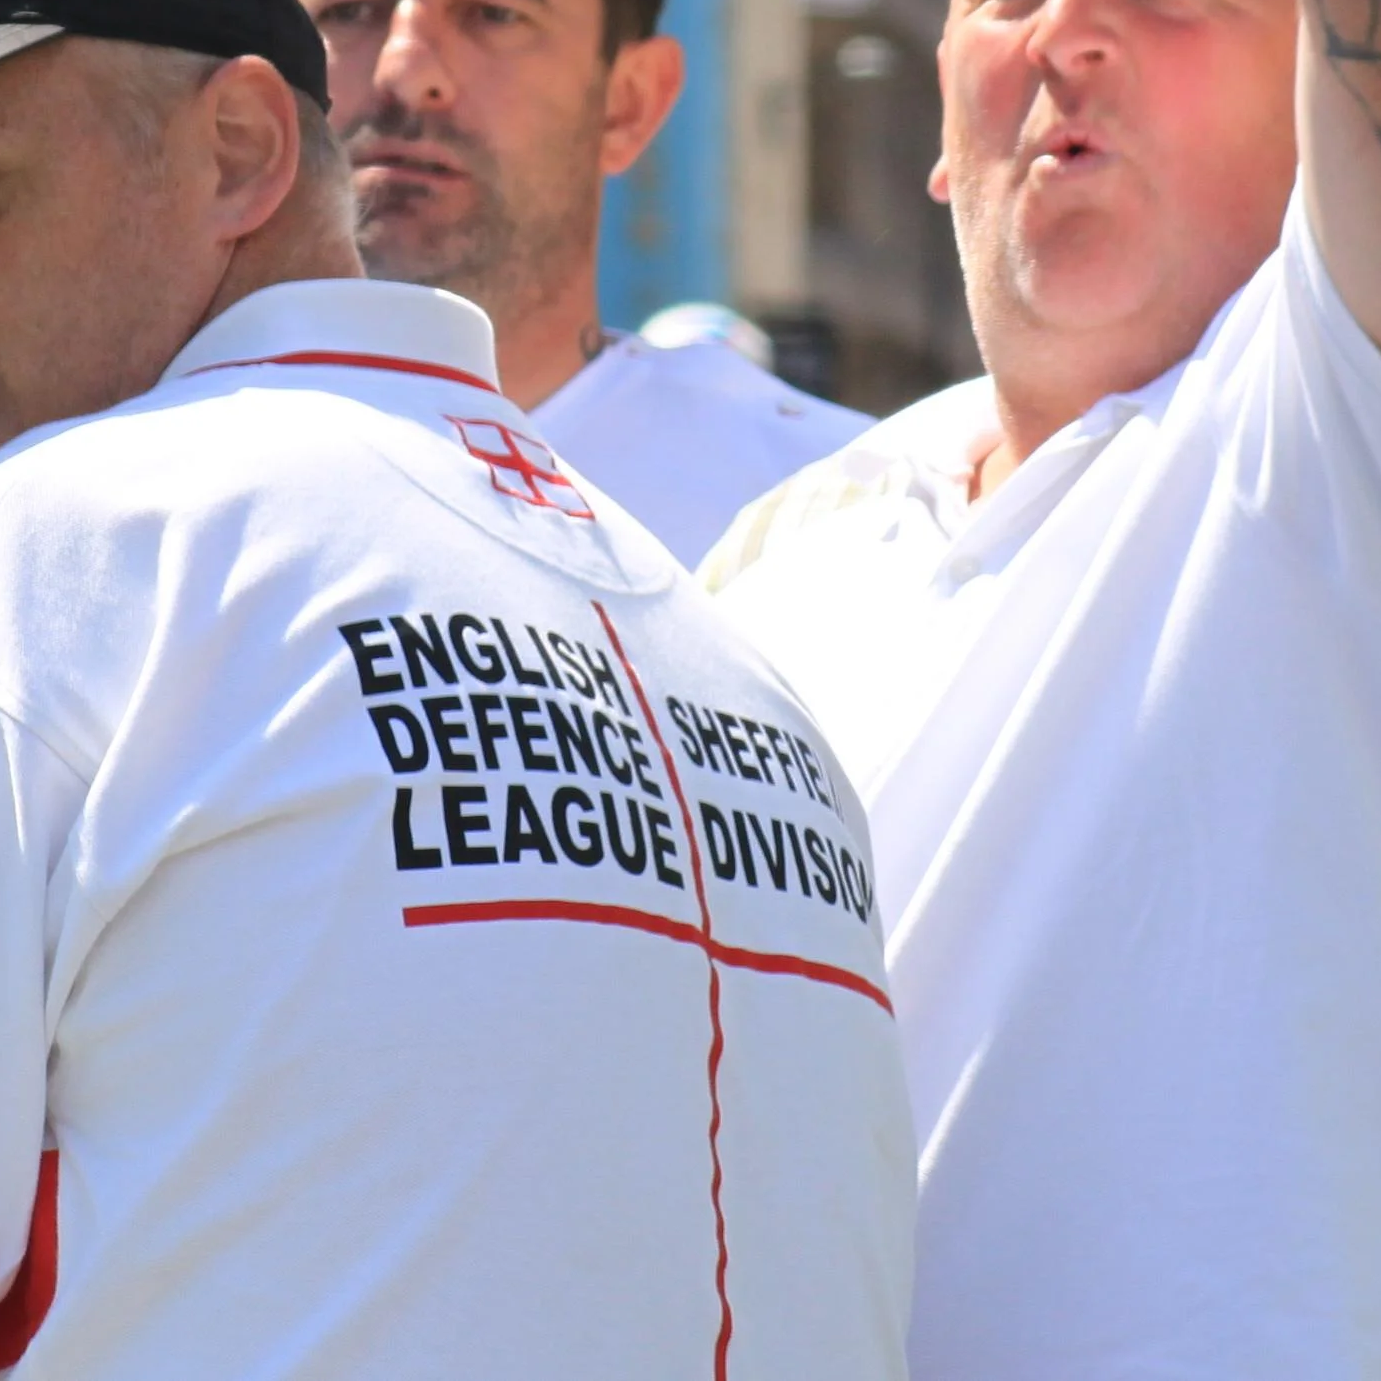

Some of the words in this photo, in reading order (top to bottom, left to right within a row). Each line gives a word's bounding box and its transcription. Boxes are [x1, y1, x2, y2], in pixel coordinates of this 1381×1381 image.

[339, 615, 630, 716] ENGLISH
[368, 693, 663, 799] DEFENCE
[666, 694, 844, 823] SHEFFIE
[392, 785, 685, 890] LEAGUE
